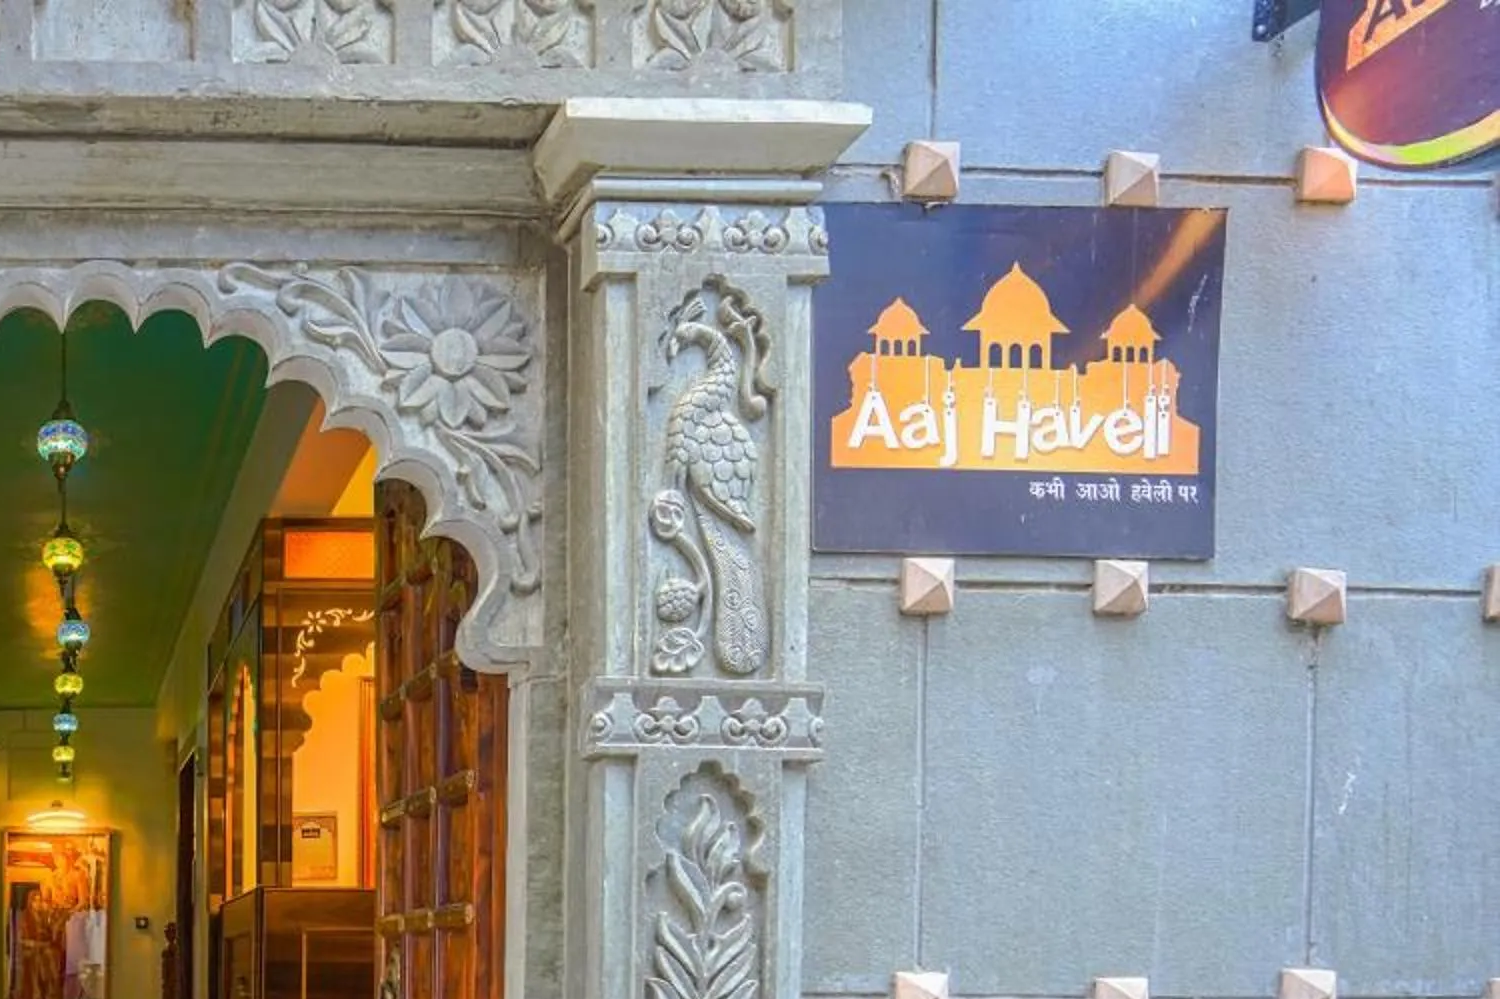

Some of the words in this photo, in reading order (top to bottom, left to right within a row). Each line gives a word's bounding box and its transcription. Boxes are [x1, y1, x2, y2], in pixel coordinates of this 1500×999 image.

[848, 389, 956, 467] Aaj
[980, 393, 1169, 460] Haveli
[1028, 476, 1065, 499] कभी
[1075, 477, 1120, 501] आओ
[1130, 478, 1173, 502] हवेली
[1177, 484, 1199, 504] पर
